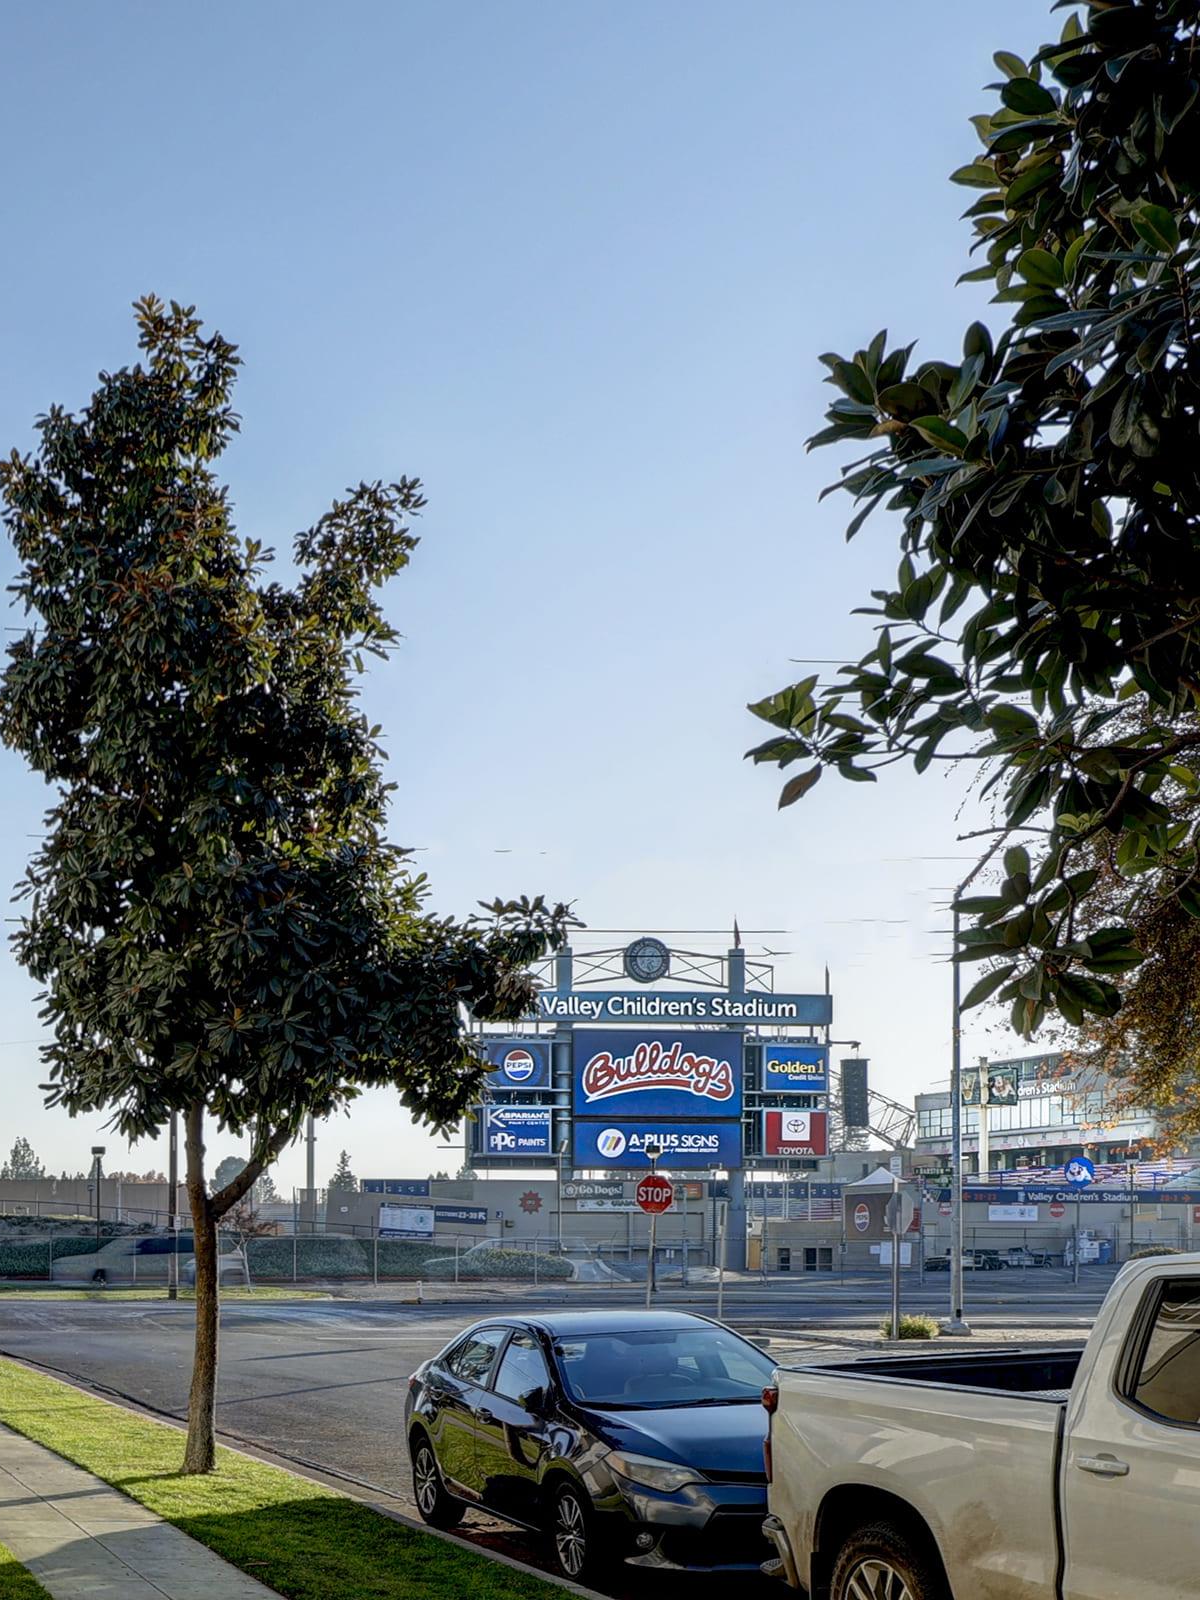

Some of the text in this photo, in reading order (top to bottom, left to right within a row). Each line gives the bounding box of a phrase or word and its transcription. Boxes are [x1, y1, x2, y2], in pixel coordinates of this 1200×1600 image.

[542, 996, 798, 1020] Valley Children's Stadium
[582, 1041, 734, 1102] Bulldogs
[767, 1060, 816, 1074] Golden
[486, 1108, 550, 1128] KASPARIAN'S
[517, 1138, 546, 1147] PAINTS
[628, 1133, 719, 1148] A-PLUS SIGNS
[777, 1146, 815, 1155] TOYOTA
[578, 1184, 623, 1196] Go Dogs!
[638, 1186, 671, 1203] STOP
[1027, 1192, 1053, 1203] Valley
[1056, 1192, 1100, 1202] Children's
